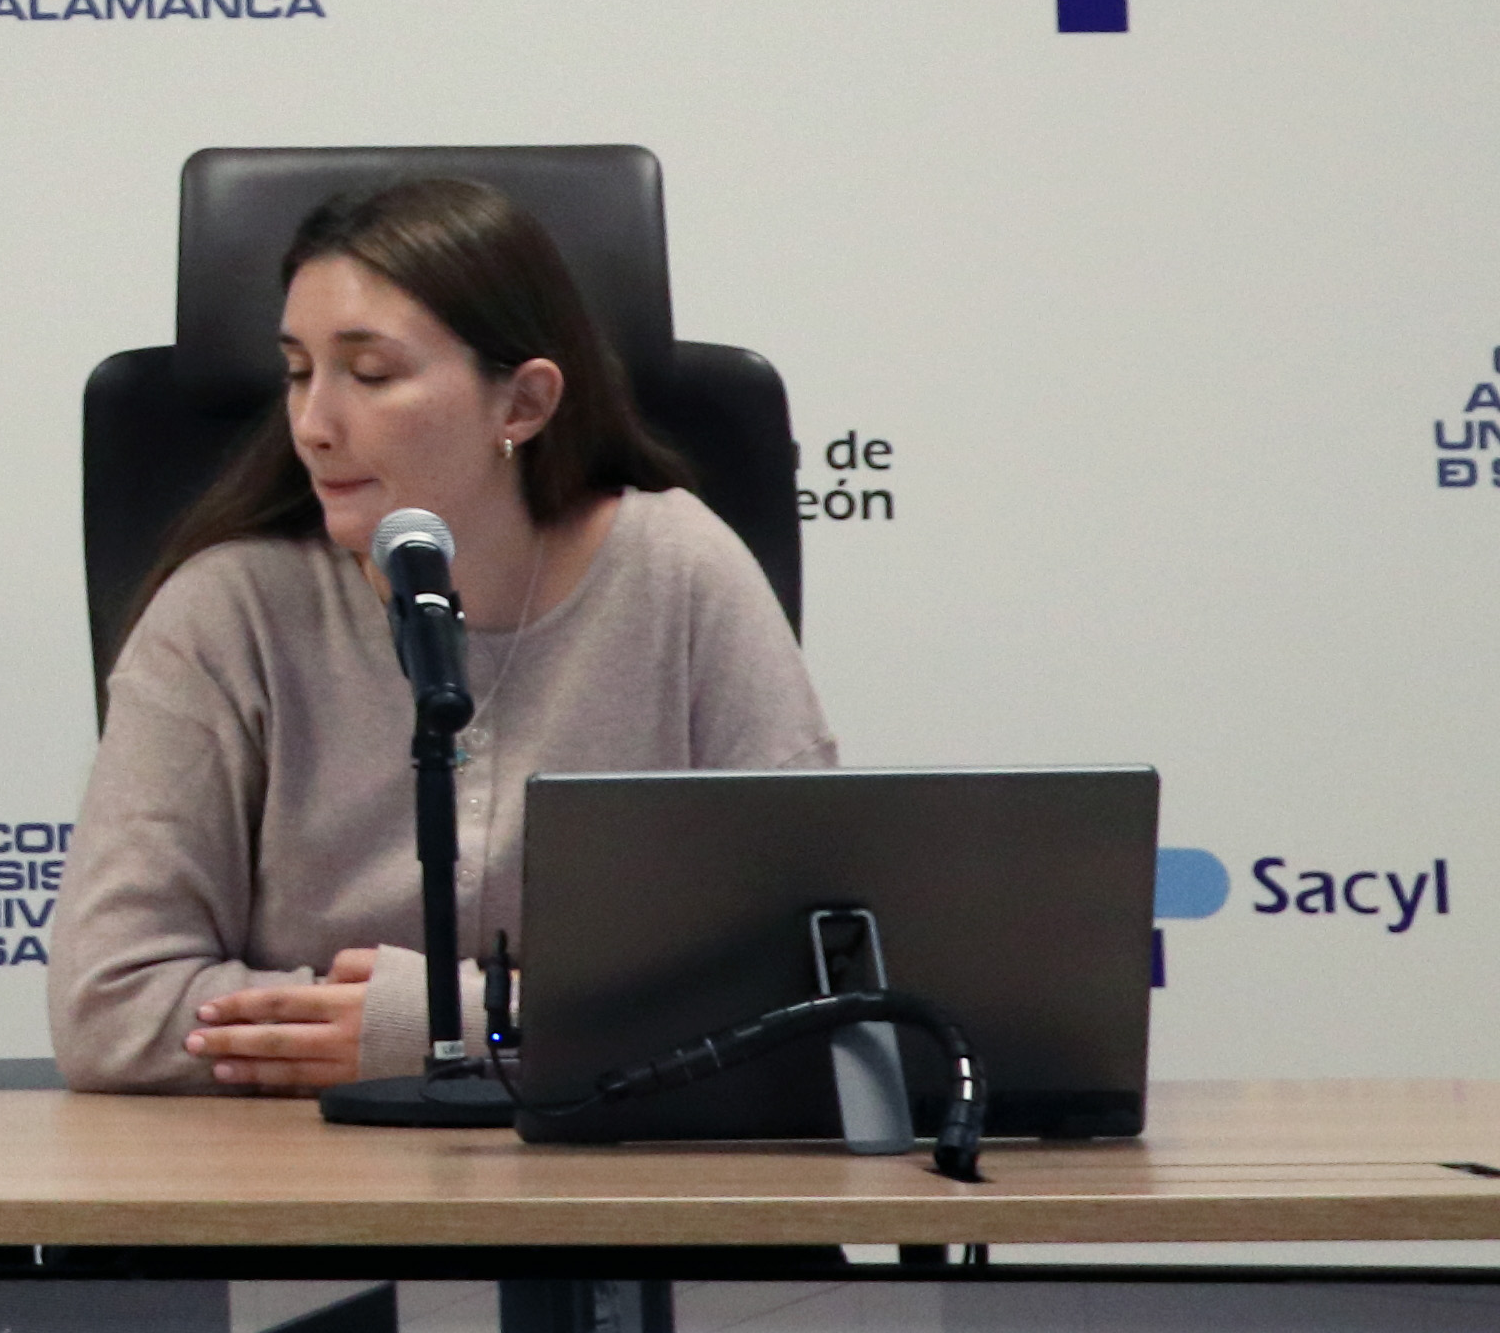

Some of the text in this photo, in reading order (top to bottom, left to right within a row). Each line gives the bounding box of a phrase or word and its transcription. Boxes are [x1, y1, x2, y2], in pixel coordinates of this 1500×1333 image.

[826, 431, 892, 470] de
[797, 478, 893, 520] eón
[1253, 858, 1448, 933] Sacyl
